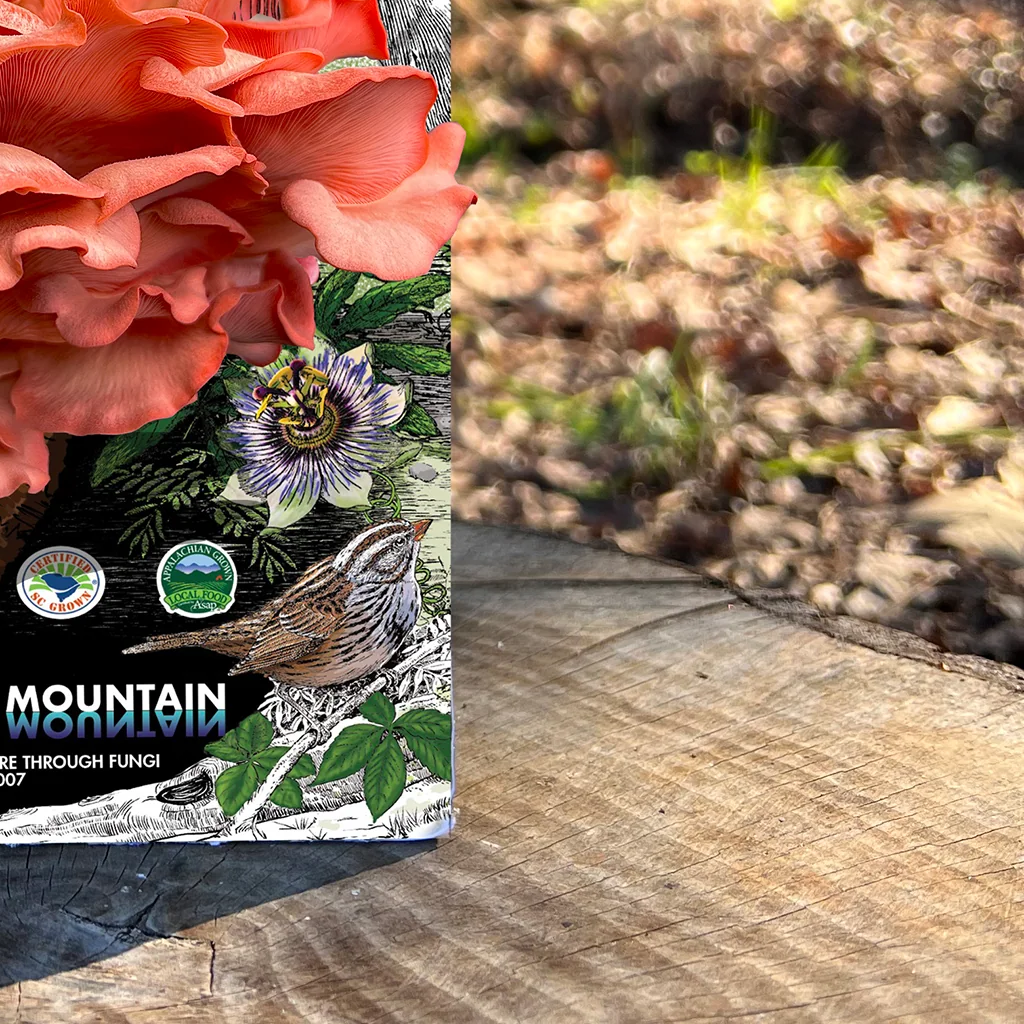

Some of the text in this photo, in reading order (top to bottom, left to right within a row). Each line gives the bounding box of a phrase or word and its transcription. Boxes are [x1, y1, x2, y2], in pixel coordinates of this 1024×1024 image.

[29, 553, 92, 574] CERTIFIED
[163, 544, 233, 583] APPALACHIAN GROWN
[30, 590, 92, 612] SC GROWN
[168, 590, 228, 605] LOCAL FOOD
[6, 683, 226, 713] MOUNTAIN
[22, 754, 104, 770] THROUGH
[109, 753, 161, 768] FUNGI
